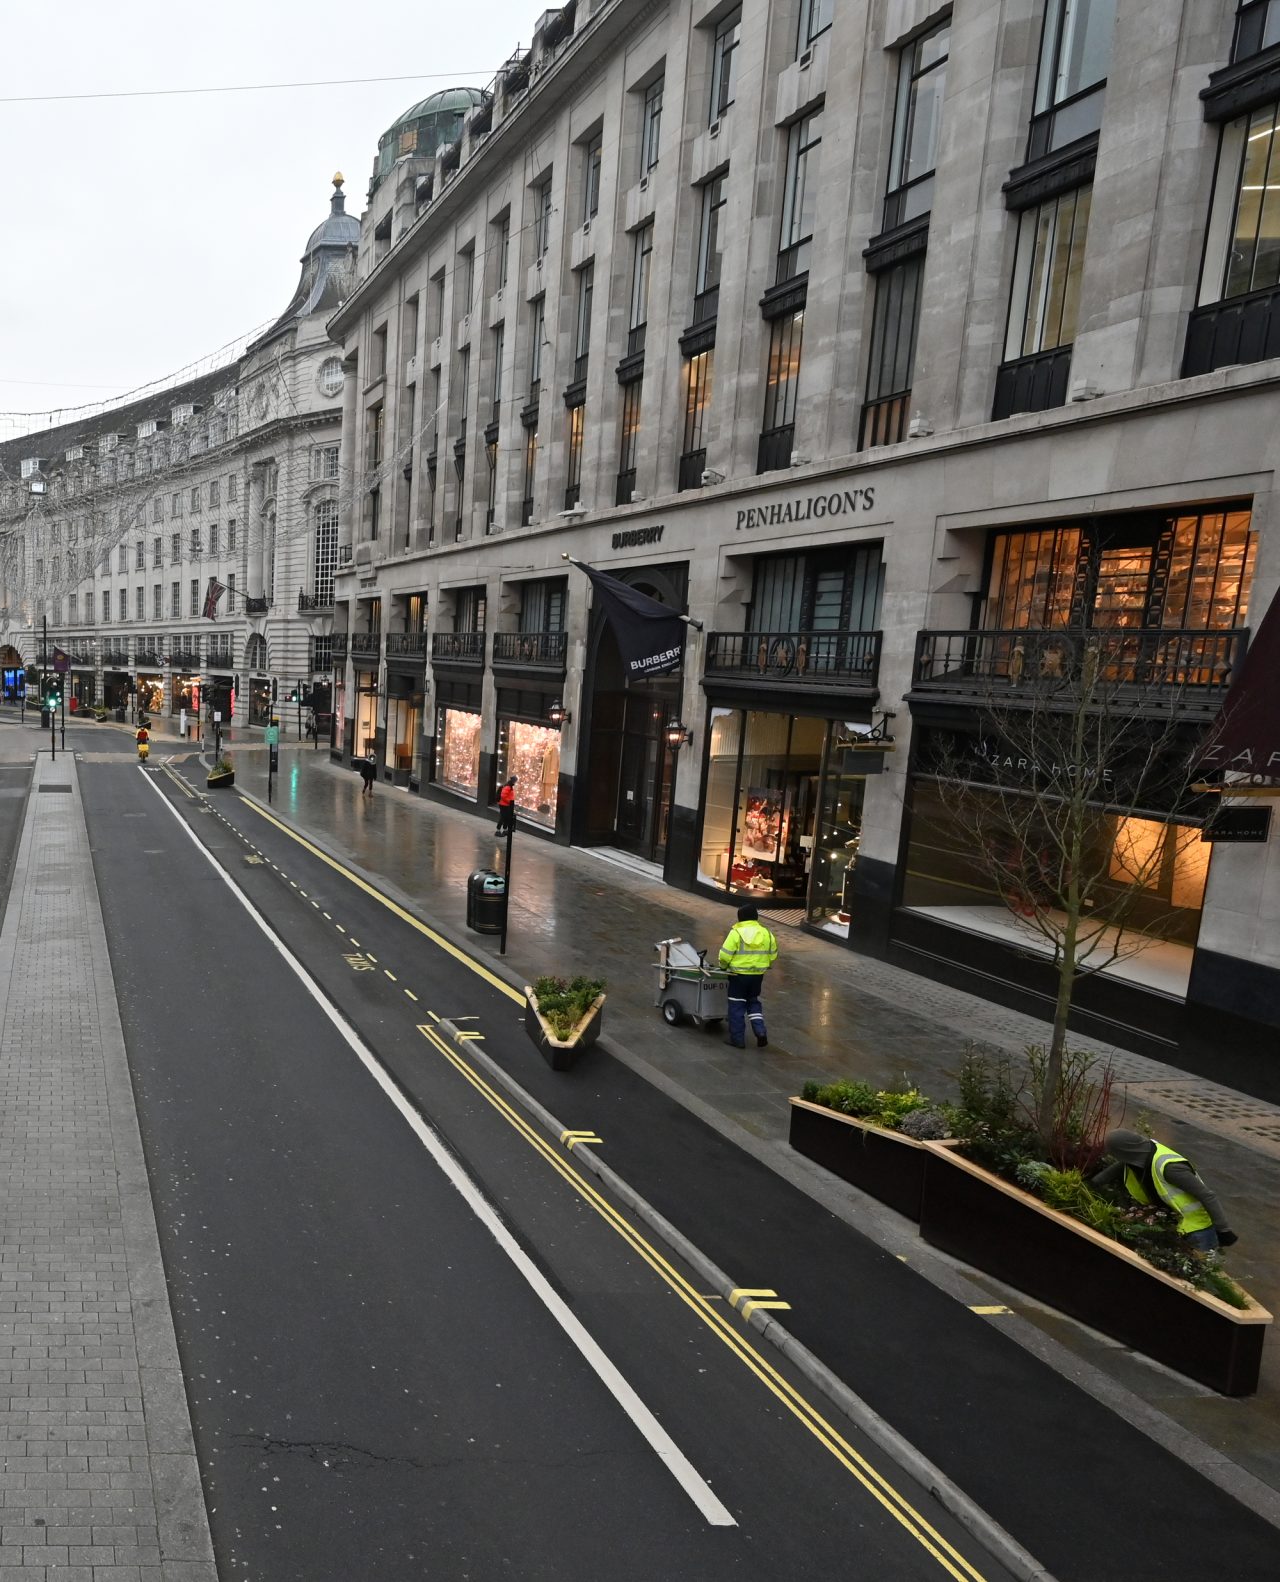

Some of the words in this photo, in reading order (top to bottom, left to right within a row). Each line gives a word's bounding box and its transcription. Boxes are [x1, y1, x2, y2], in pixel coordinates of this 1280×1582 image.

[735, 486, 875, 530] PENHALIGON'S
[611, 525, 664, 550] BURBERRY
[630, 645, 681, 670] BURBERR
[990, 754, 1041, 772] ZARA
